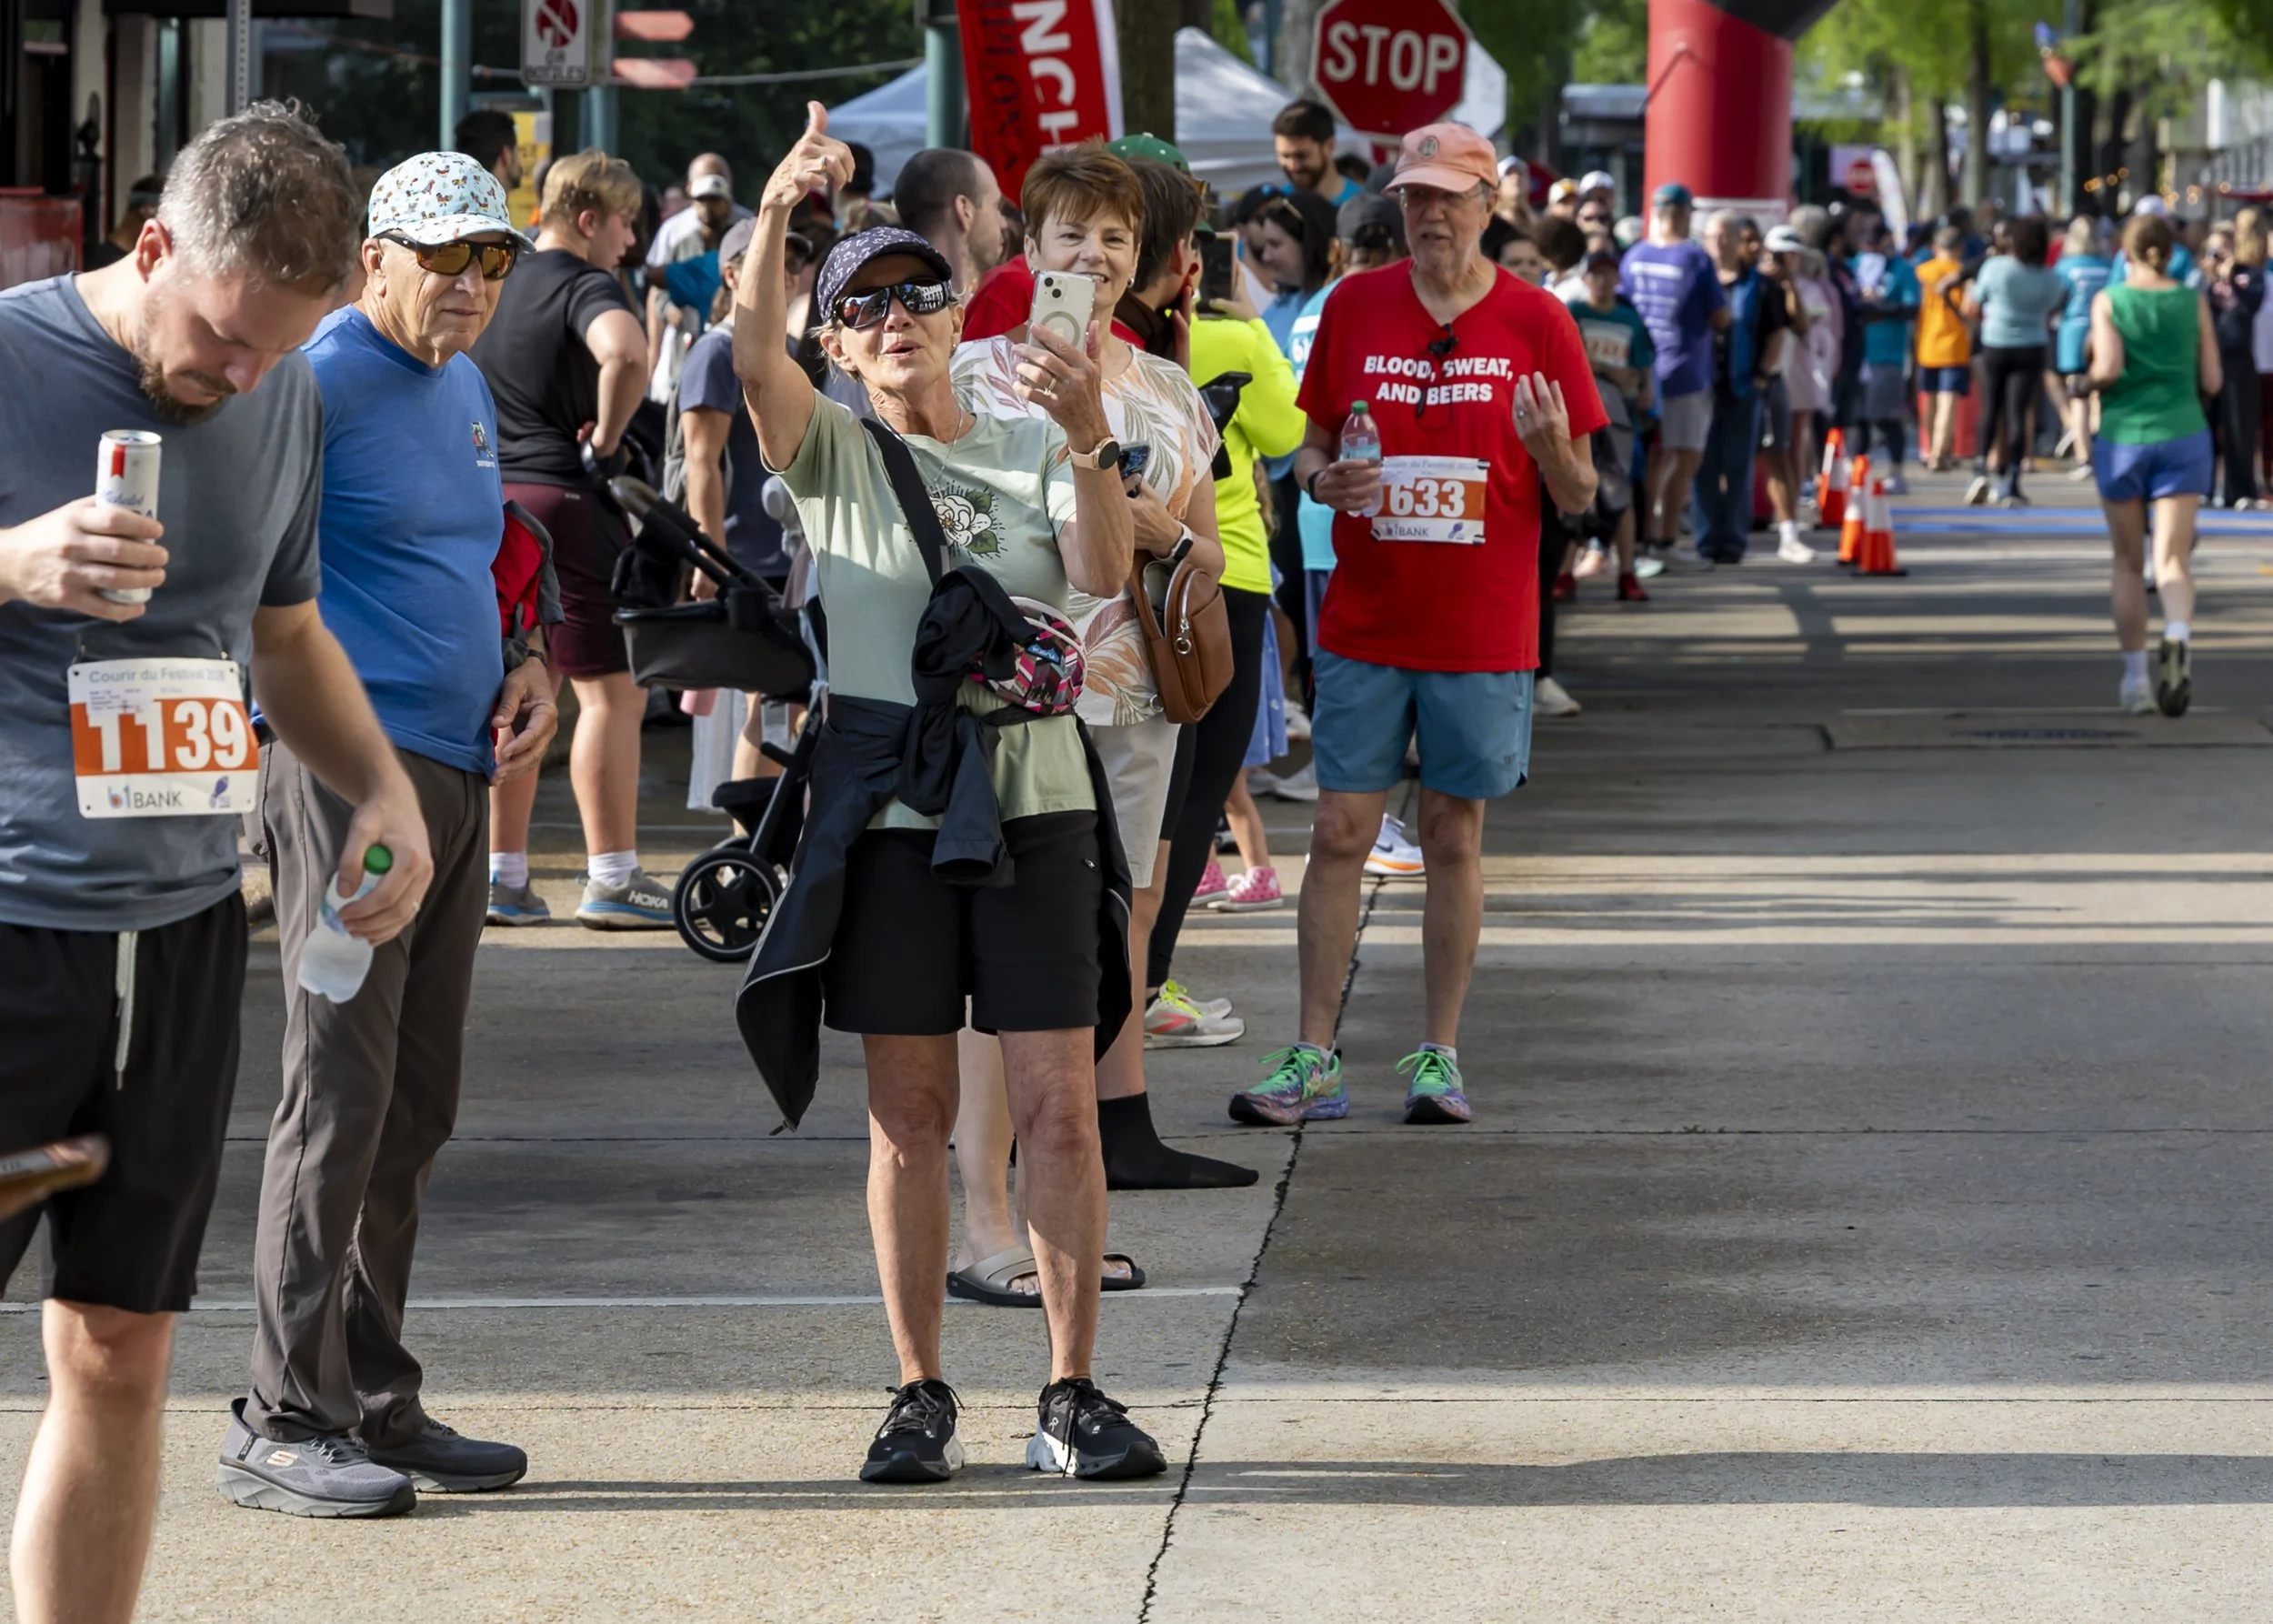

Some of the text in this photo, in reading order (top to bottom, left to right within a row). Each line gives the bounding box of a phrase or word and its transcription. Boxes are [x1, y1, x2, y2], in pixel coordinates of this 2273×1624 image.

[1323, 20, 1460, 95] STOP
[1364, 356, 1514, 382] BLOOD, SWEAT,
[1376, 382, 1494, 406] AND BEERS
[1389, 478, 1466, 518] 633
[88, 670, 136, 683] Courir
[143, 668, 158, 681] du
[88, 700, 247, 772] 1139
[627, 890, 668, 908] HOKA
